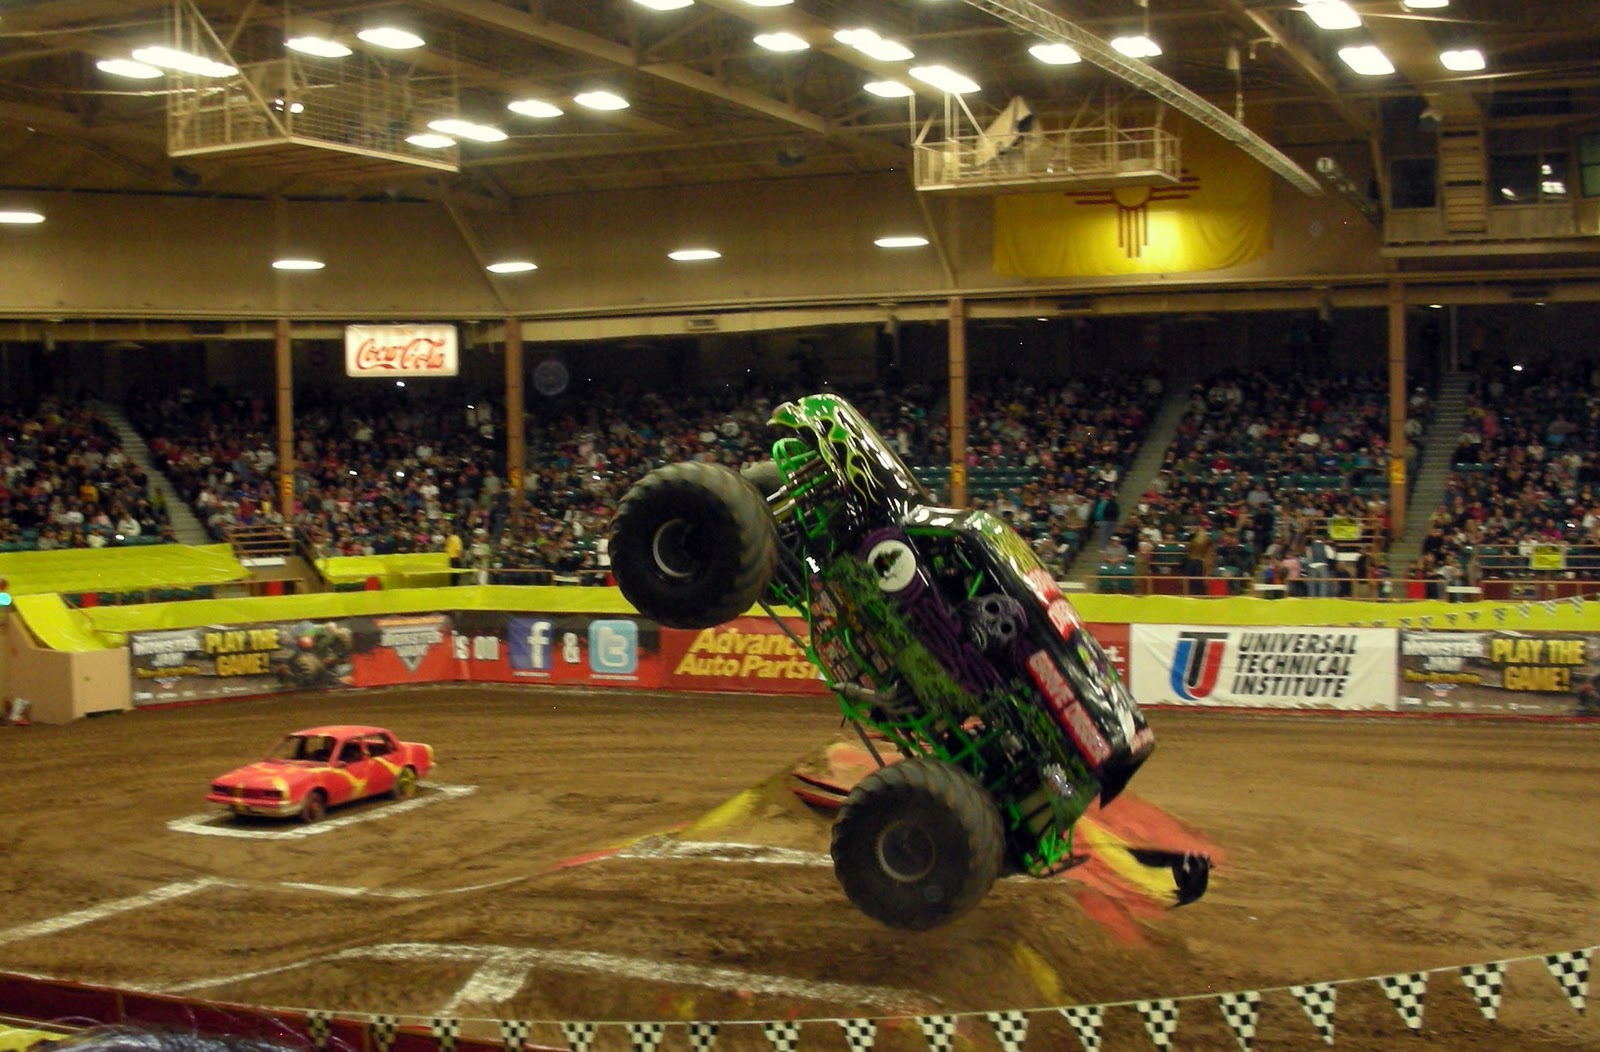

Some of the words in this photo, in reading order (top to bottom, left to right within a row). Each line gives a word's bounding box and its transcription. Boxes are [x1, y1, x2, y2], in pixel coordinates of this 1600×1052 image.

[204, 632, 245, 653] PLAY
[562, 632, 581, 663] &
[1238, 632, 1359, 655] UNIVERSAL
[1492, 638, 1545, 663] PLAY
[1545, 640, 1586, 665] THE
[216, 652, 270, 677] GAME!
[673, 653, 740, 677] Auto
[1235, 653, 1352, 677] TECHNICAL
[1230, 675, 1348, 698] INSTITUTE
[1503, 666, 1570, 692] GAME!
